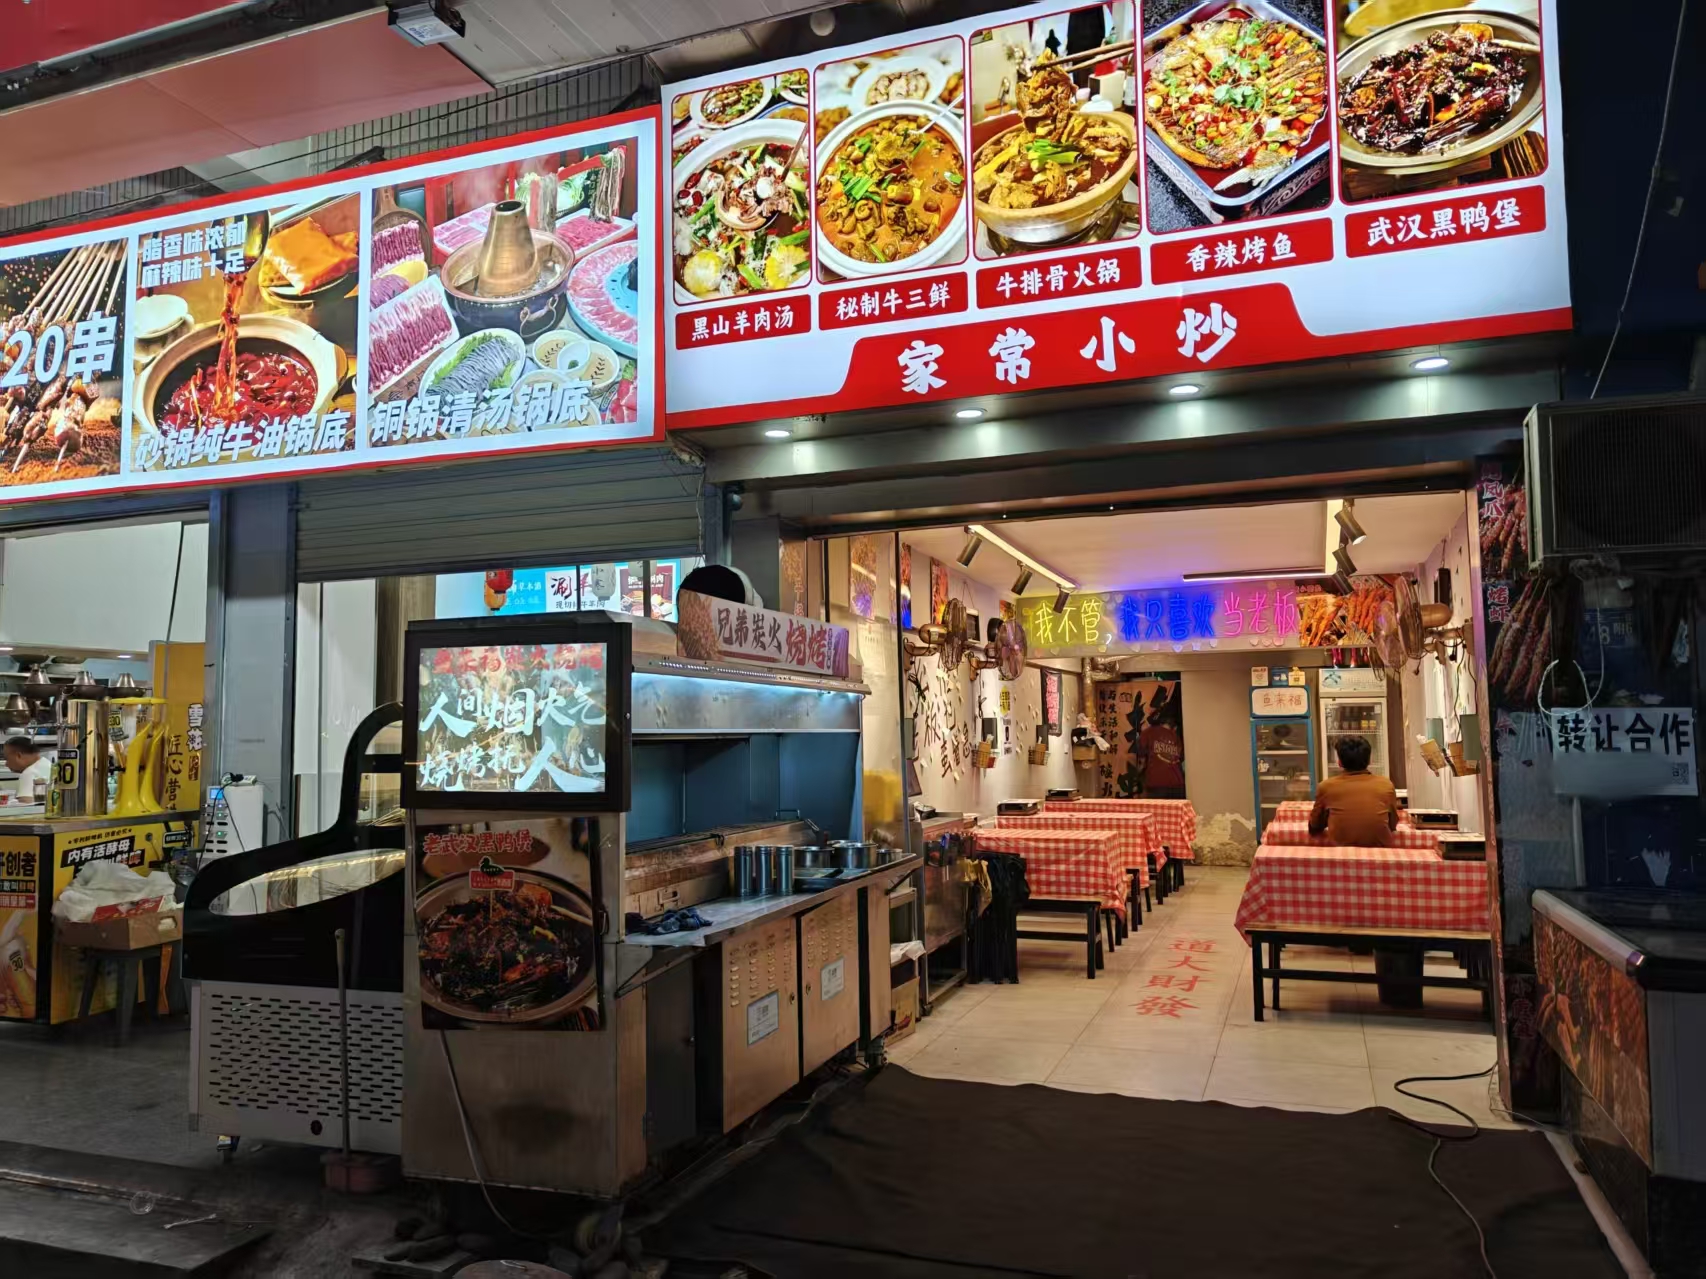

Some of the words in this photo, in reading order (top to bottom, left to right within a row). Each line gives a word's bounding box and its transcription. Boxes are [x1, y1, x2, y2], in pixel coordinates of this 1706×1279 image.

[141, 250, 246, 289] 麻辣味十足
[1186, 232, 1297, 272] 香辣烤鱼
[996, 258, 1120, 299] 牛排骨火锅
[835, 280, 951, 321] 秘制牛三鲜
[692, 305, 794, 342] 黑山羊肉汤
[898, 303, 1237, 395] 家常小炒
[372, 379, 593, 442] 铜锅清汤锅底
[136, 410, 352, 468] 砂锅纯牛油锅底
[419, 681, 606, 737] 人间烟火气
[1557, 713, 1691, 755] 转让合作
[165, 735, 183, 811] 匠心营
[67, 839, 131, 864] 内有活酵母
